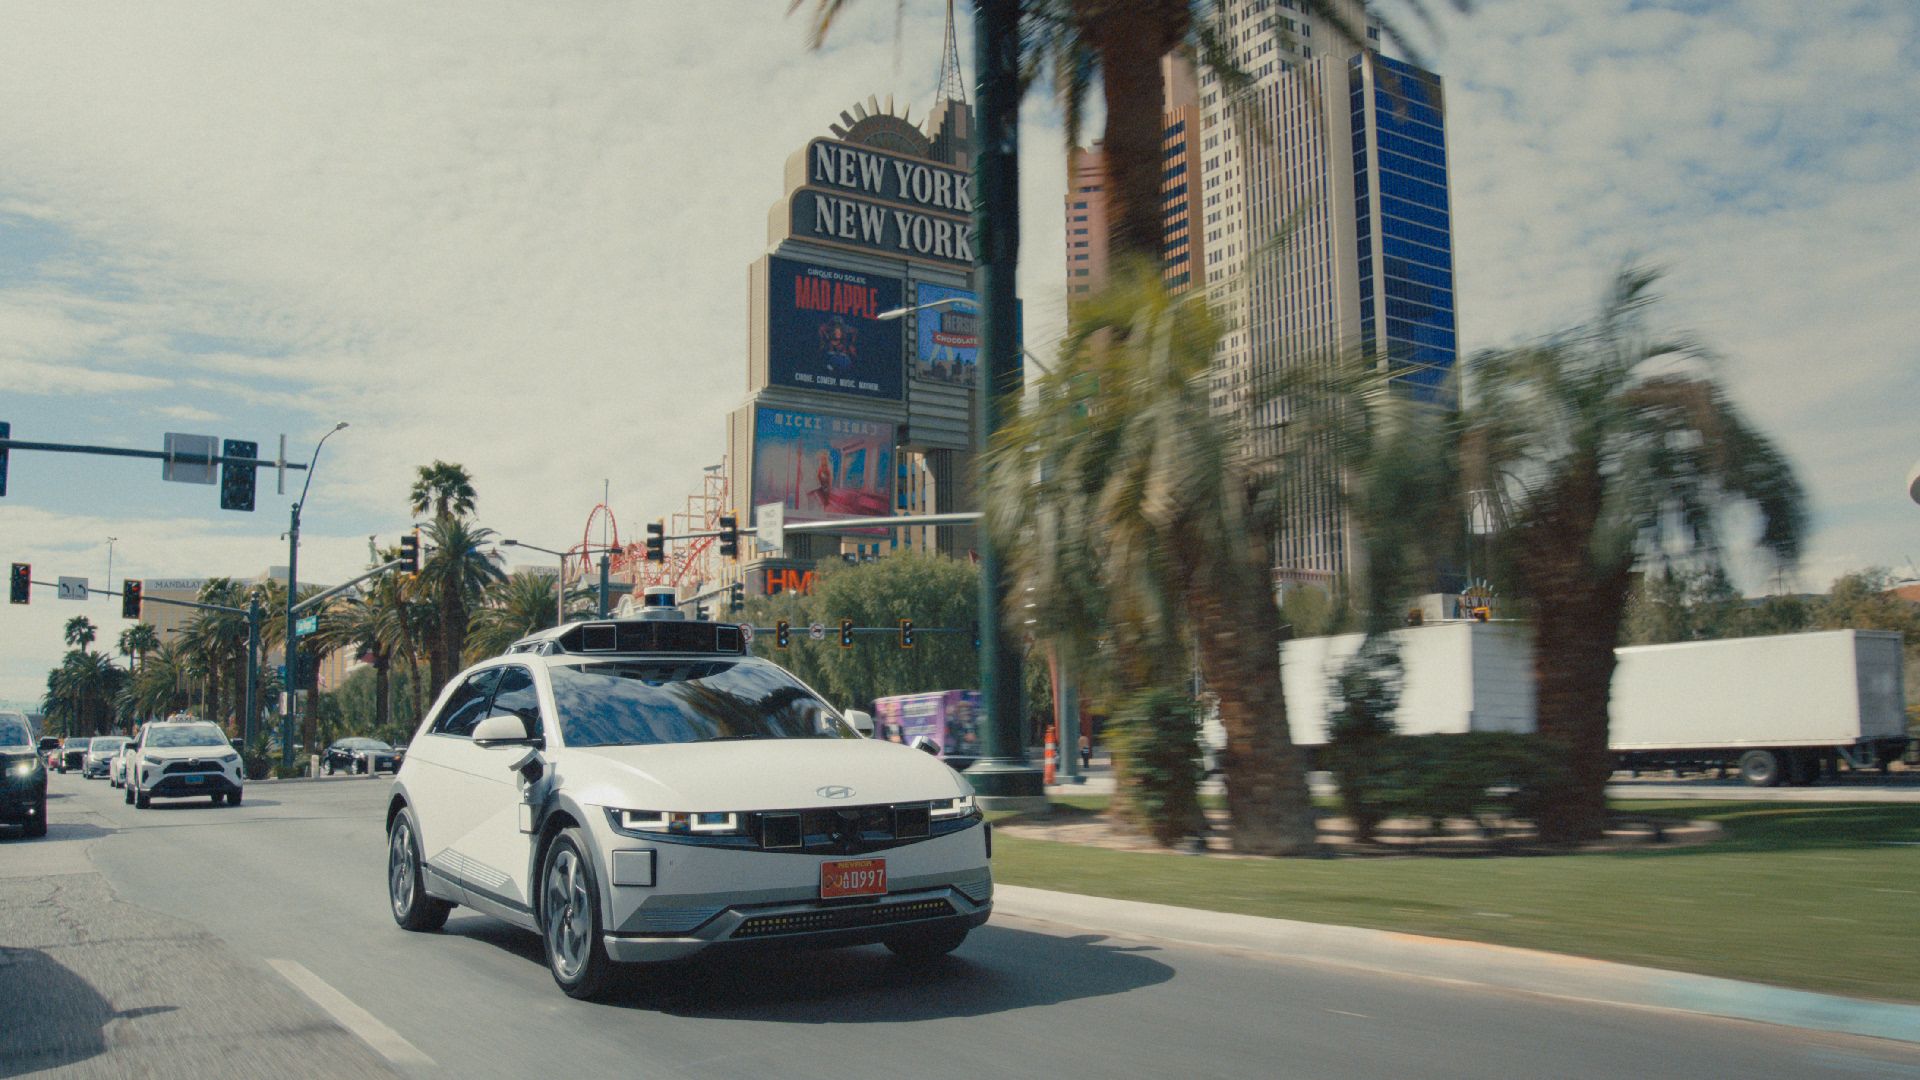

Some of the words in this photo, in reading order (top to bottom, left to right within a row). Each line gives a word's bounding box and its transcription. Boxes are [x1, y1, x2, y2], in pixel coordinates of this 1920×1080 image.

[815, 142, 887, 194] NEW
[893, 159, 974, 212] YORK
[814, 194, 887, 245] NEW
[894, 210, 974, 262] YORK
[807, 268, 832, 279] CIRQUE
[795, 274, 831, 312] MAD
[833, 280, 878, 321] APPLE
[775, 413, 821, 430] NICKI
